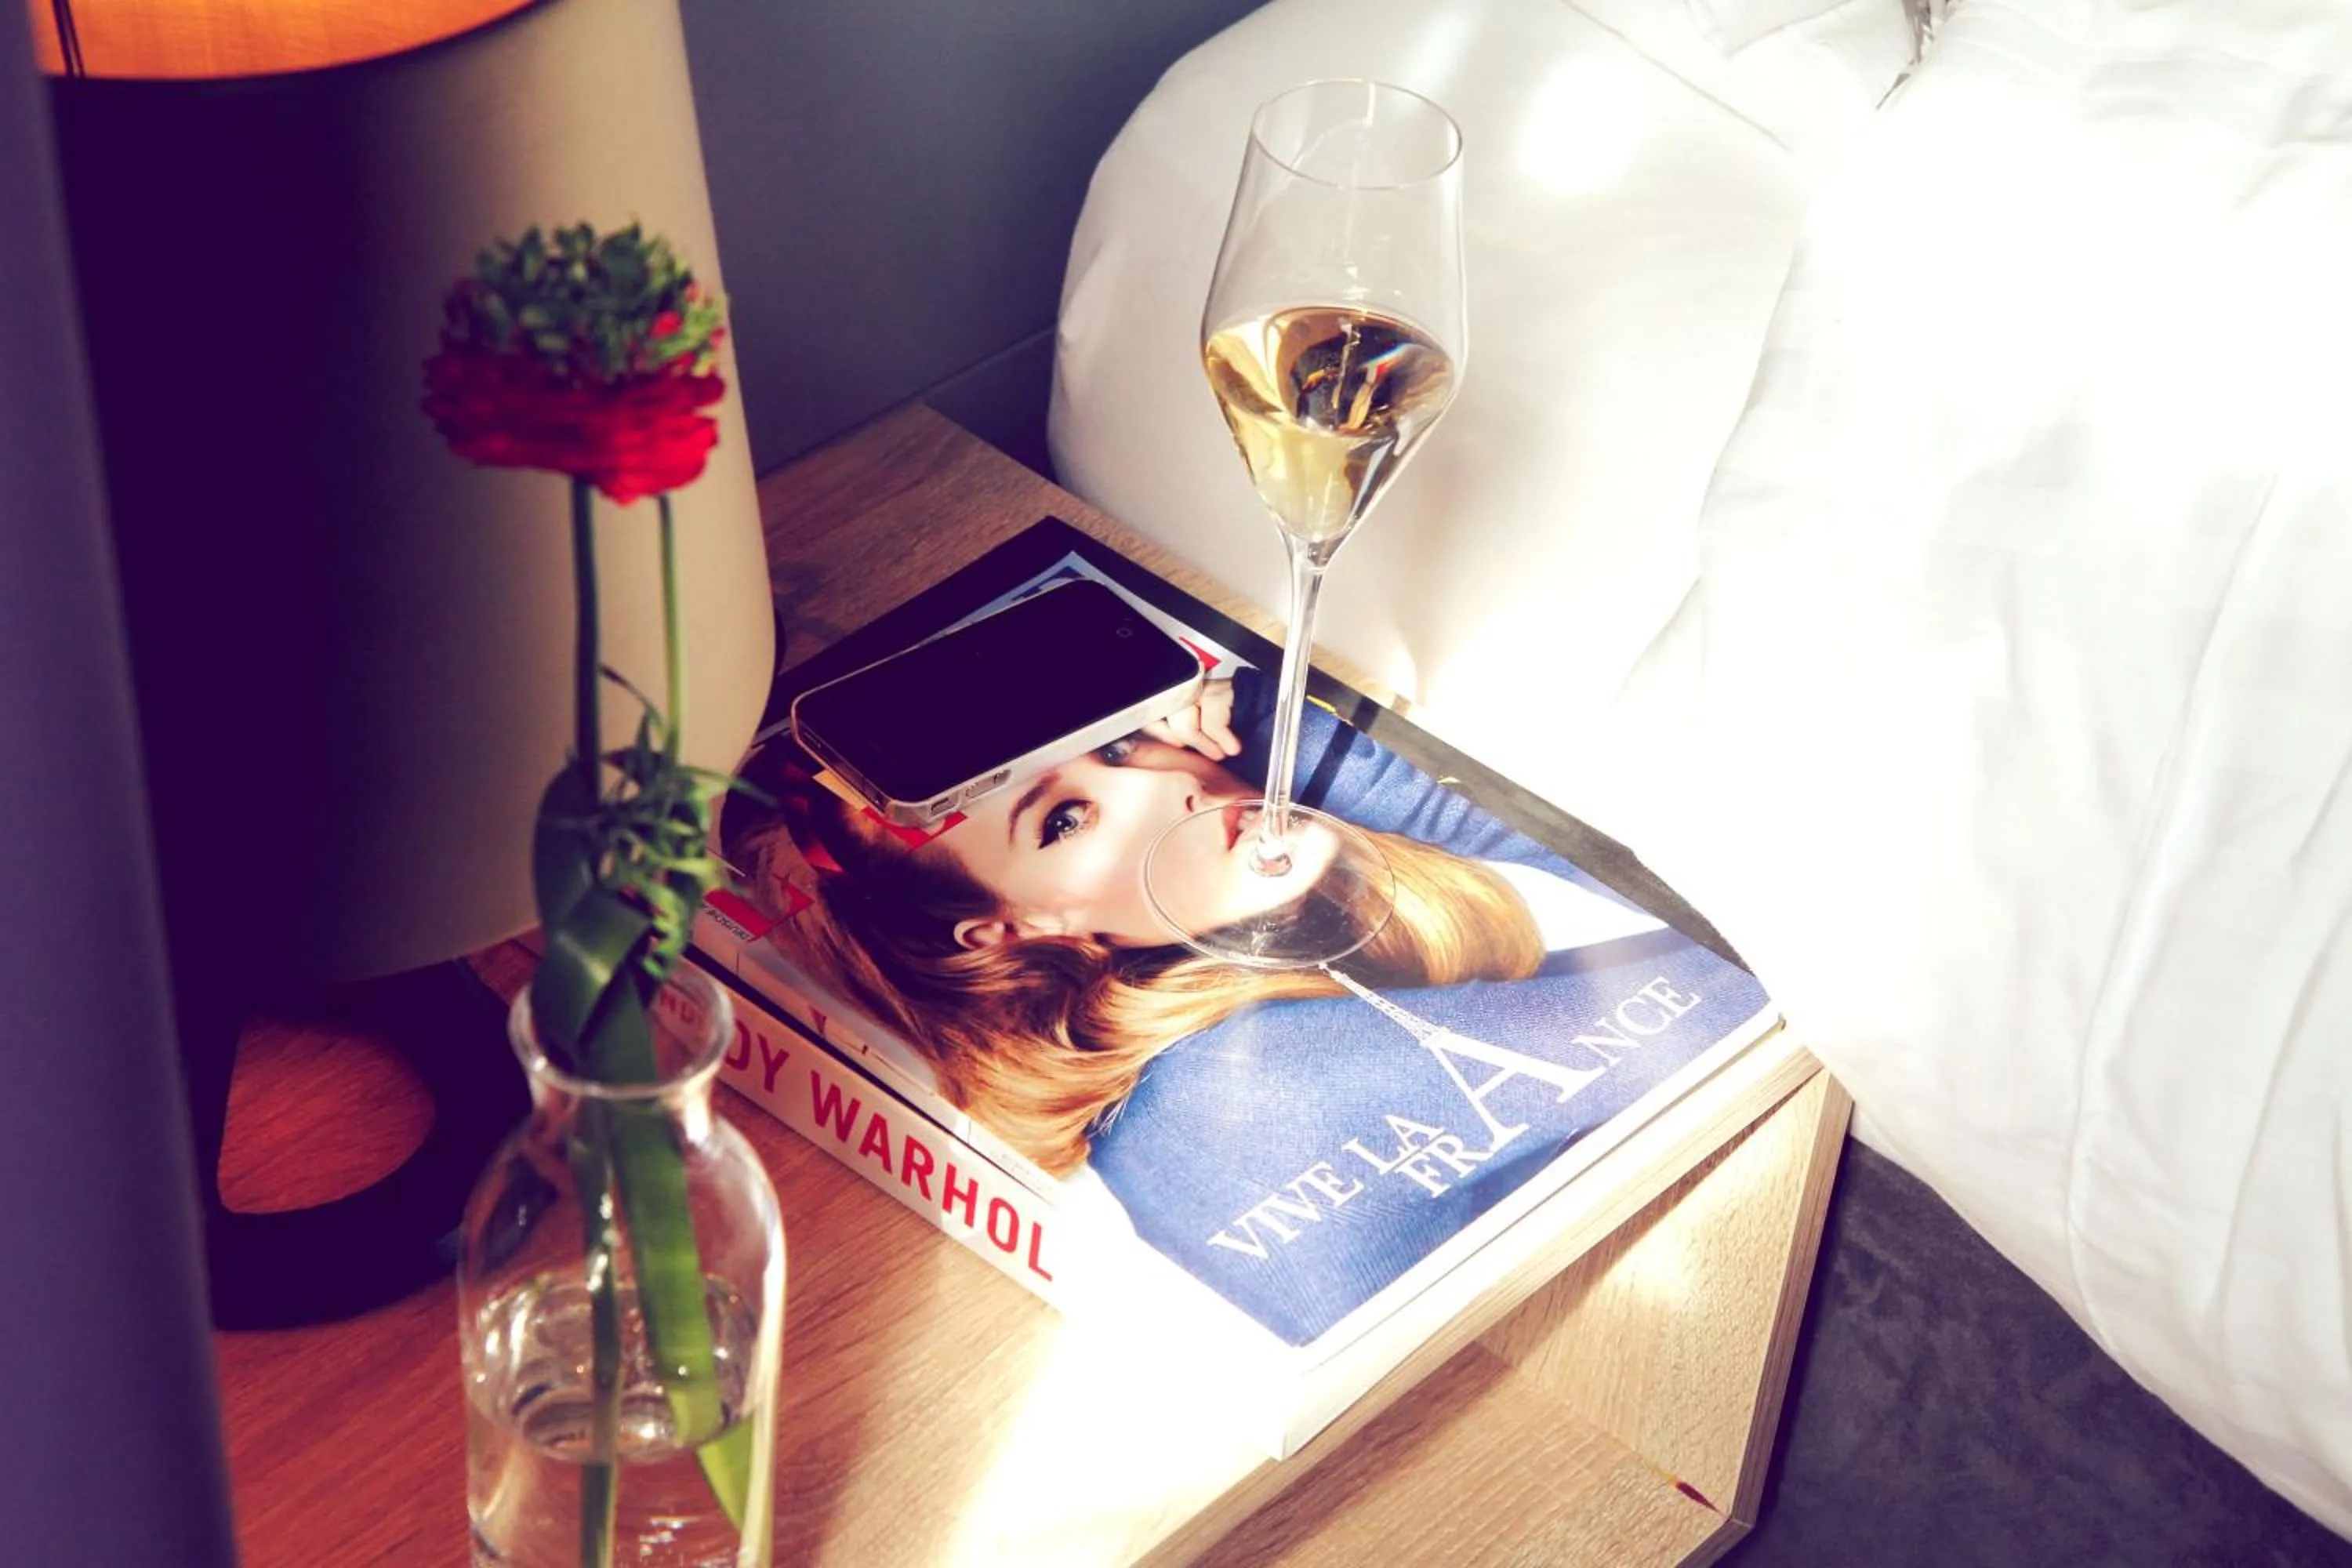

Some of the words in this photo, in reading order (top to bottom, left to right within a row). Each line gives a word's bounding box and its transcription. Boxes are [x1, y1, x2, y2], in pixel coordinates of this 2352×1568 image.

[810, 1069, 1053, 1283] WARHOL
[1207, 1162, 1363, 1263] VIVE
[1342, 1113, 1445, 1176] LA
[1392, 975, 1702, 1199] FRANCE
